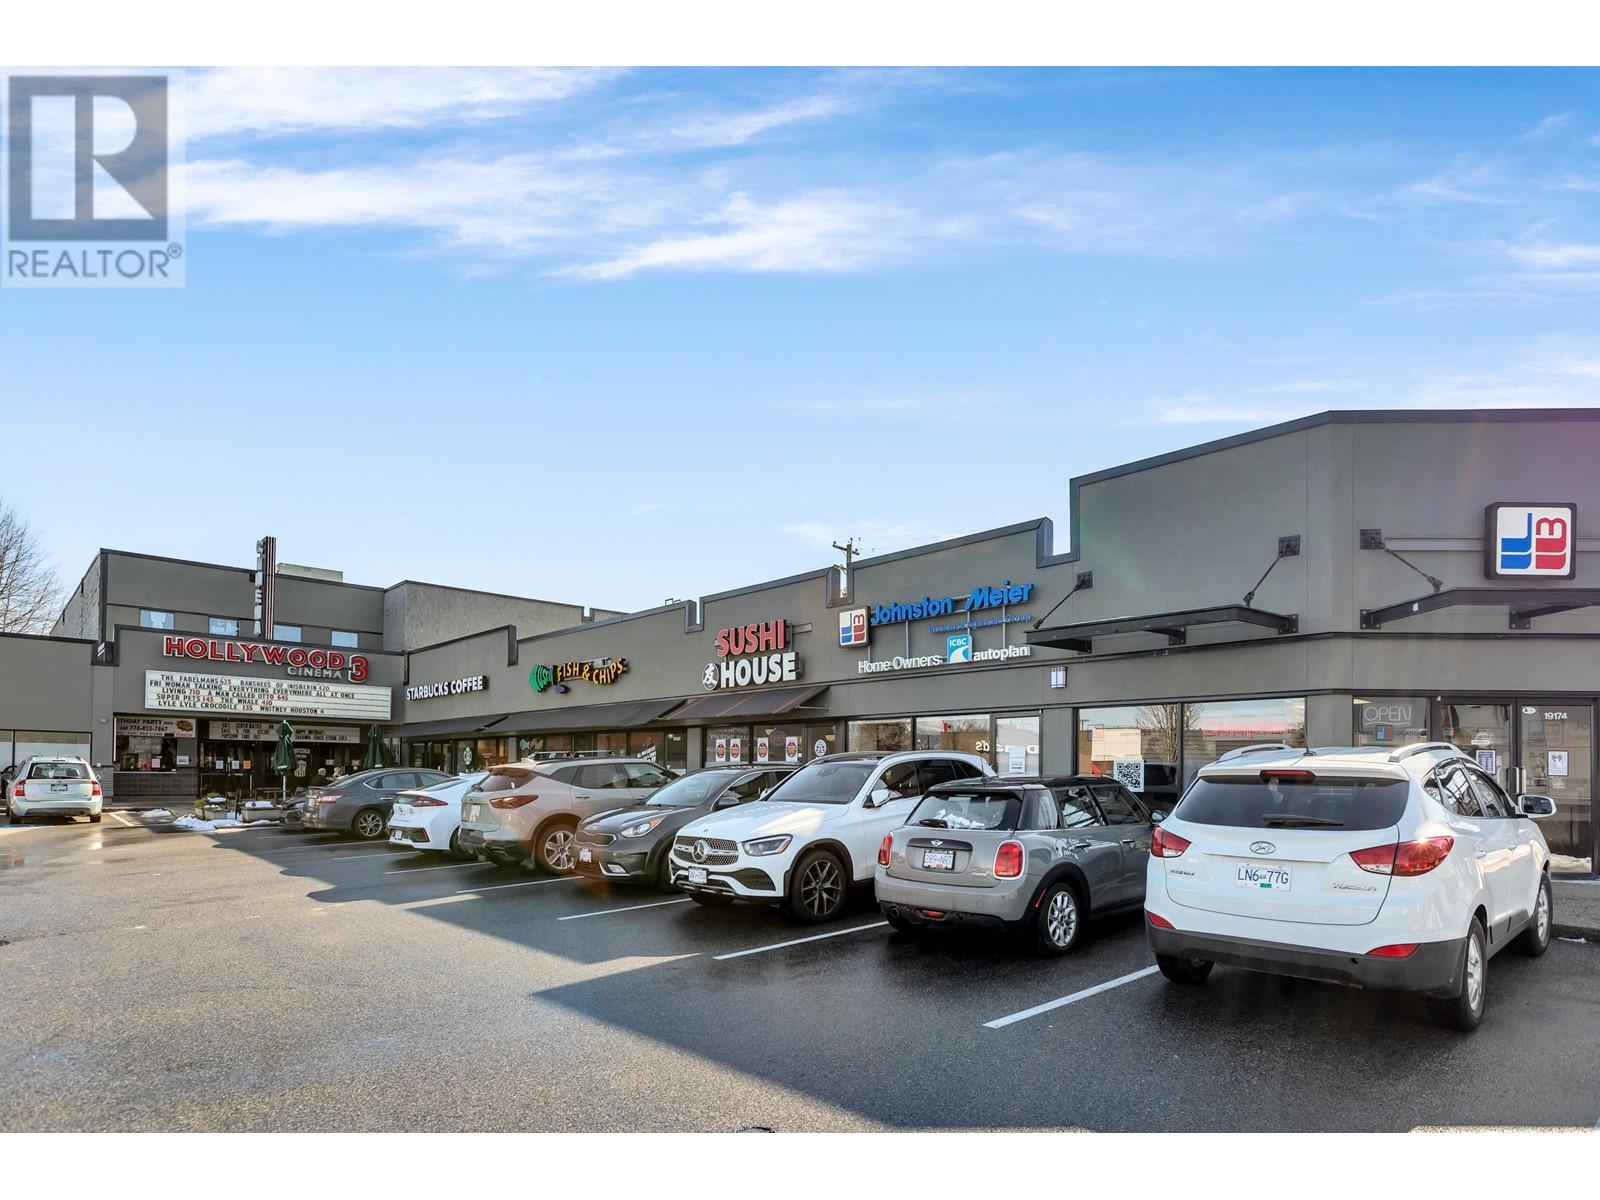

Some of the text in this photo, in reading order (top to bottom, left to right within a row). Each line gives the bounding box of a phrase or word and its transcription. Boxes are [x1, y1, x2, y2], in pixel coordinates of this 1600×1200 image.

[870, 580, 1034, 625] Johnston Meier
[716, 619, 785, 657] SUSHI
[949, 637, 967, 647] ICBC
[163, 635, 369, 683] HOLLYWOOD 3
[973, 645, 1031, 661] autoplan
[557, 662, 579, 682] FISH
[582, 664, 590, 681] &
[592, 658, 623, 685] CHIPS
[720, 652, 796, 688] HOUSE
[858, 655, 943, 674] Home Owners
[287, 666, 343, 680] CINEMA
[179, 675, 219, 684] FABELMANS
[240, 679, 271, 688] BANSHEES
[406, 675, 484, 701] STARBUCKS COFFEE
[229, 686, 270, 694] EVERYTHING
[273, 688, 312, 696] EVERYWHERE
[1364, 705, 1412, 721] OPEN
[1544, 712, 1568, 720] 19174
[1238, 868, 1259, 882] LN6
[1267, 870, 1289, 884] 77G
